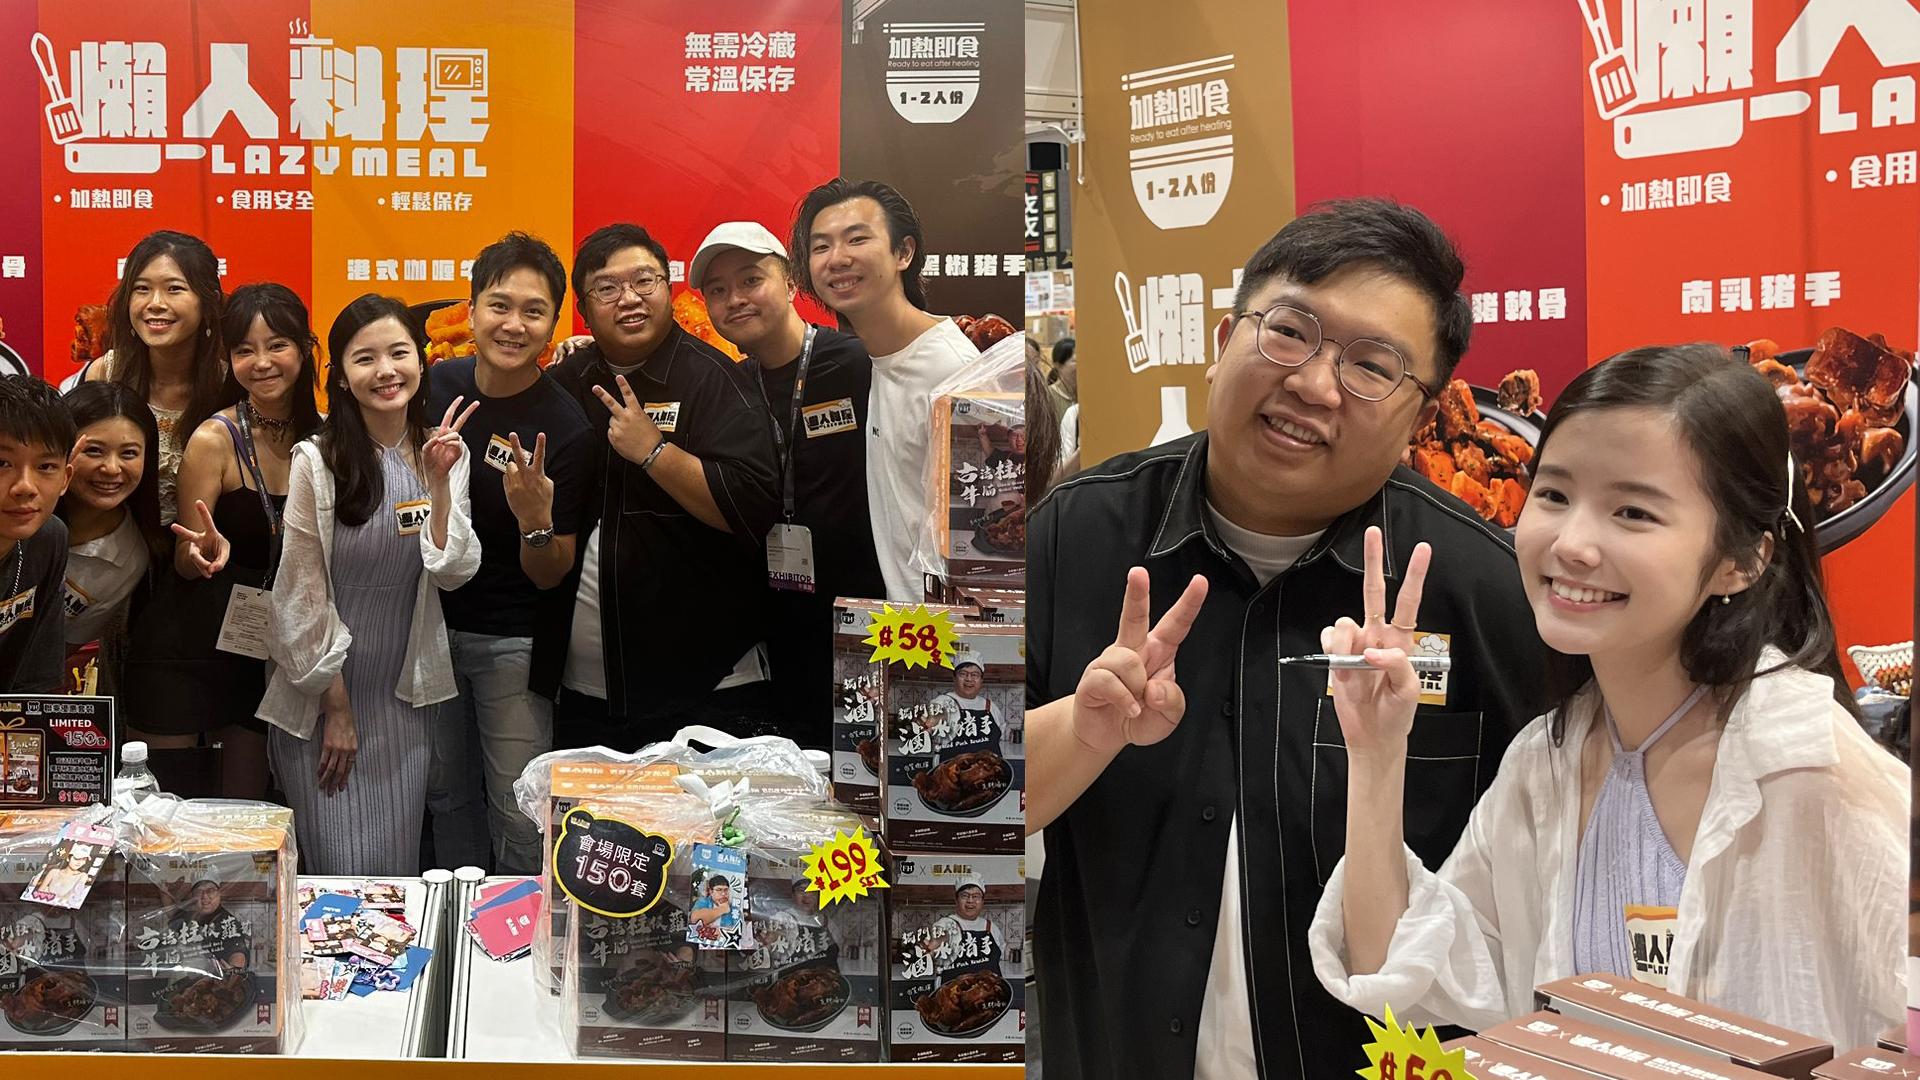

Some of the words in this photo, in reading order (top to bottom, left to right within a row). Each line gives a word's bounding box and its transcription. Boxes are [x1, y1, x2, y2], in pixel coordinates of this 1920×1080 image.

[685, 31, 796, 59] 無需冷藏
[889, 36, 980, 59] 加熱即食
[887, 60, 910, 68] Ready
[912, 60, 919, 68] to
[920, 60, 933, 68] eat
[934, 60, 950, 68] after
[951, 59, 980, 68] heating
[34, 32, 490, 144] 懶人料理
[685, 65, 796, 93] 常溫保存
[1129, 79, 1231, 130] 加熱即食
[1130, 131, 1155, 144] Ready
[1156, 129, 1165, 140] to
[1165, 127, 1180, 138] eat
[1180, 123, 1199, 134] after
[1200, 119, 1232, 131] heating
[70, 188, 154, 210] 加熱即食
[231, 189, 315, 211] 食用安全
[391, 191, 473, 212] 輕鬆保存
[1621, 172, 1732, 213] 加熱即食
[1681, 271, 1841, 315] 南乳豬手
[768, 571, 813, 585] EXHIBITOR
[49, 718, 92, 728] LIMITED
[579, 834, 651, 873] 會場限定
[575, 855, 648, 899] 150套
[859, 874, 880, 888] SET
